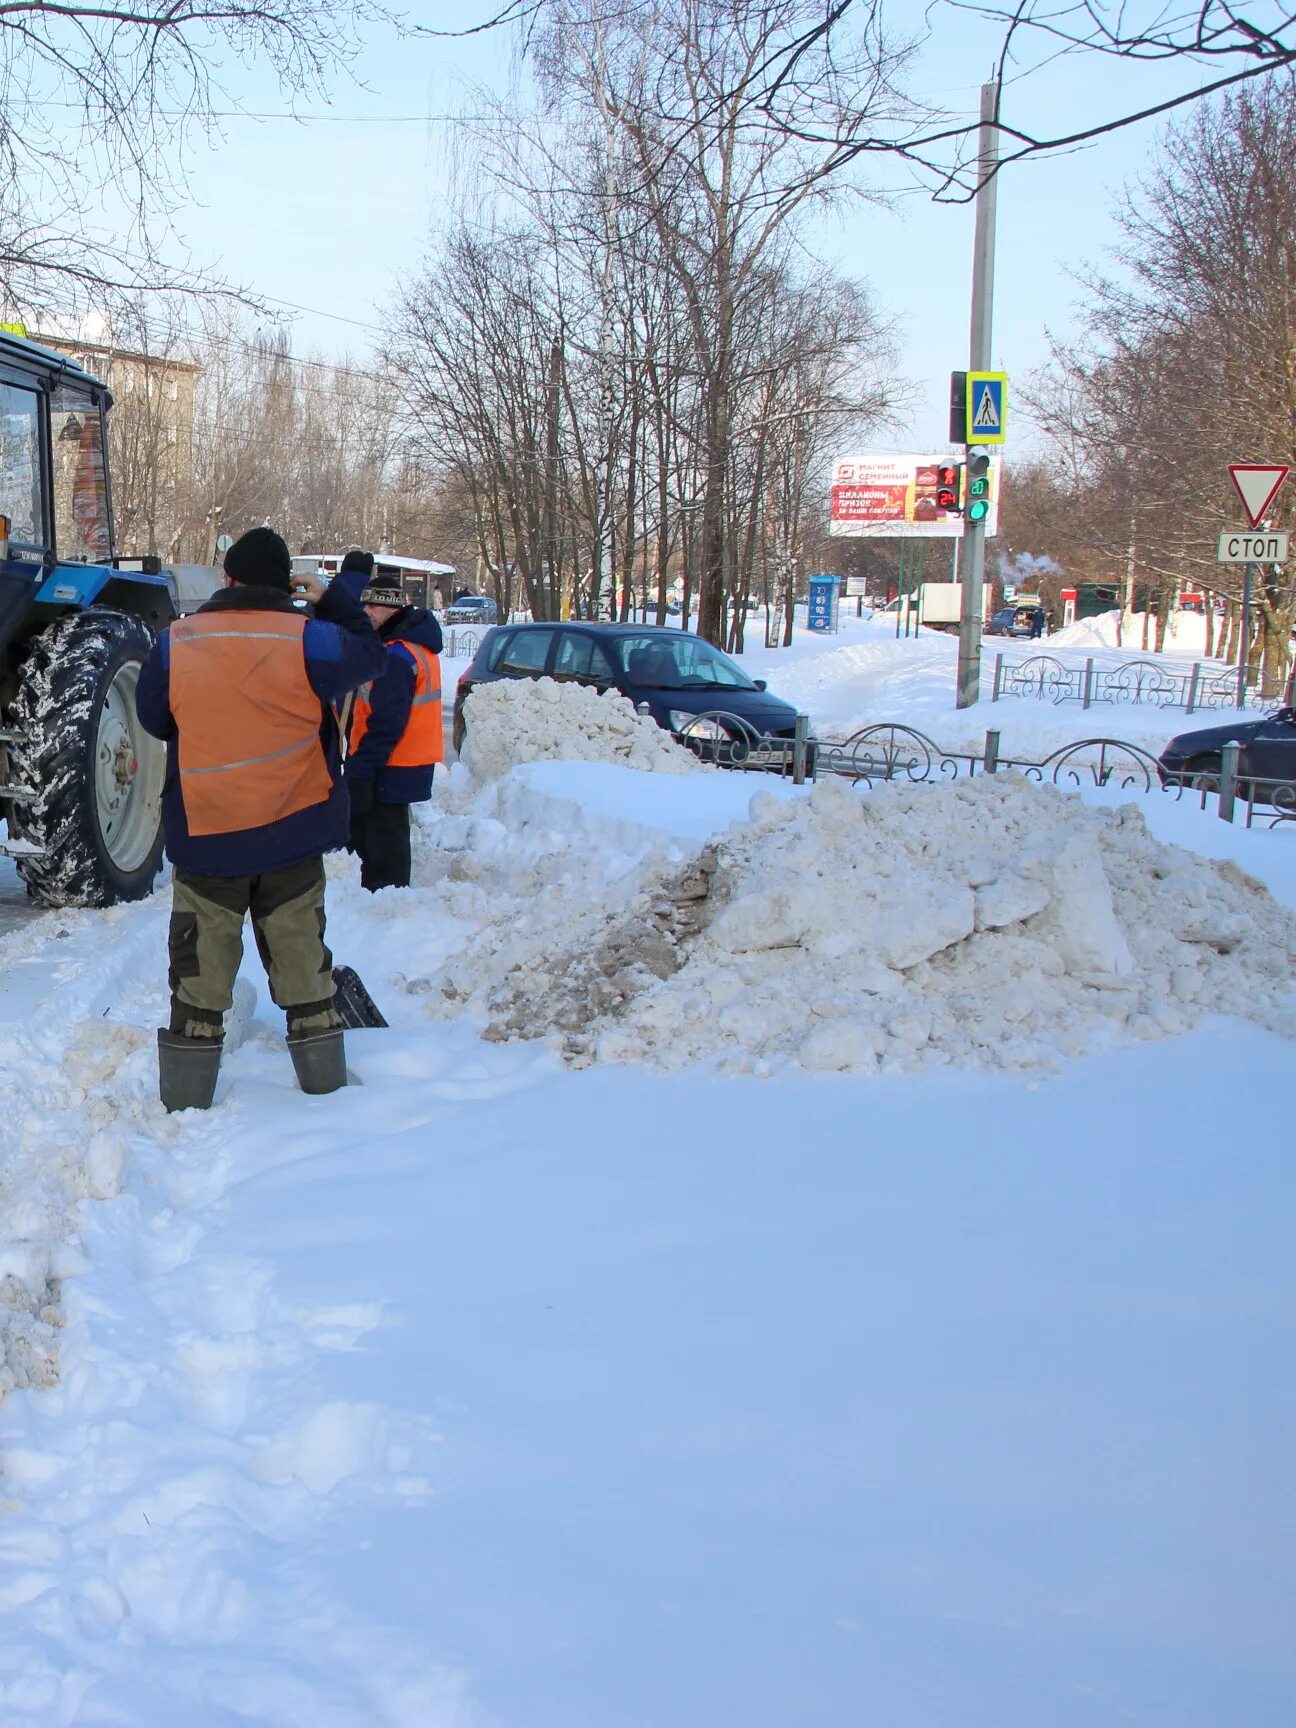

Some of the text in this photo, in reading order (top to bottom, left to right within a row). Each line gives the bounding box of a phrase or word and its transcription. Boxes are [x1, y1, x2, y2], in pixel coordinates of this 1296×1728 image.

[859, 463, 896, 471] МАГНИТ
[859, 472, 909, 480] СЕМЕЙНЫЙ
[940, 492, 956, 505] 24
[1228, 538, 1278, 557] СТОП
